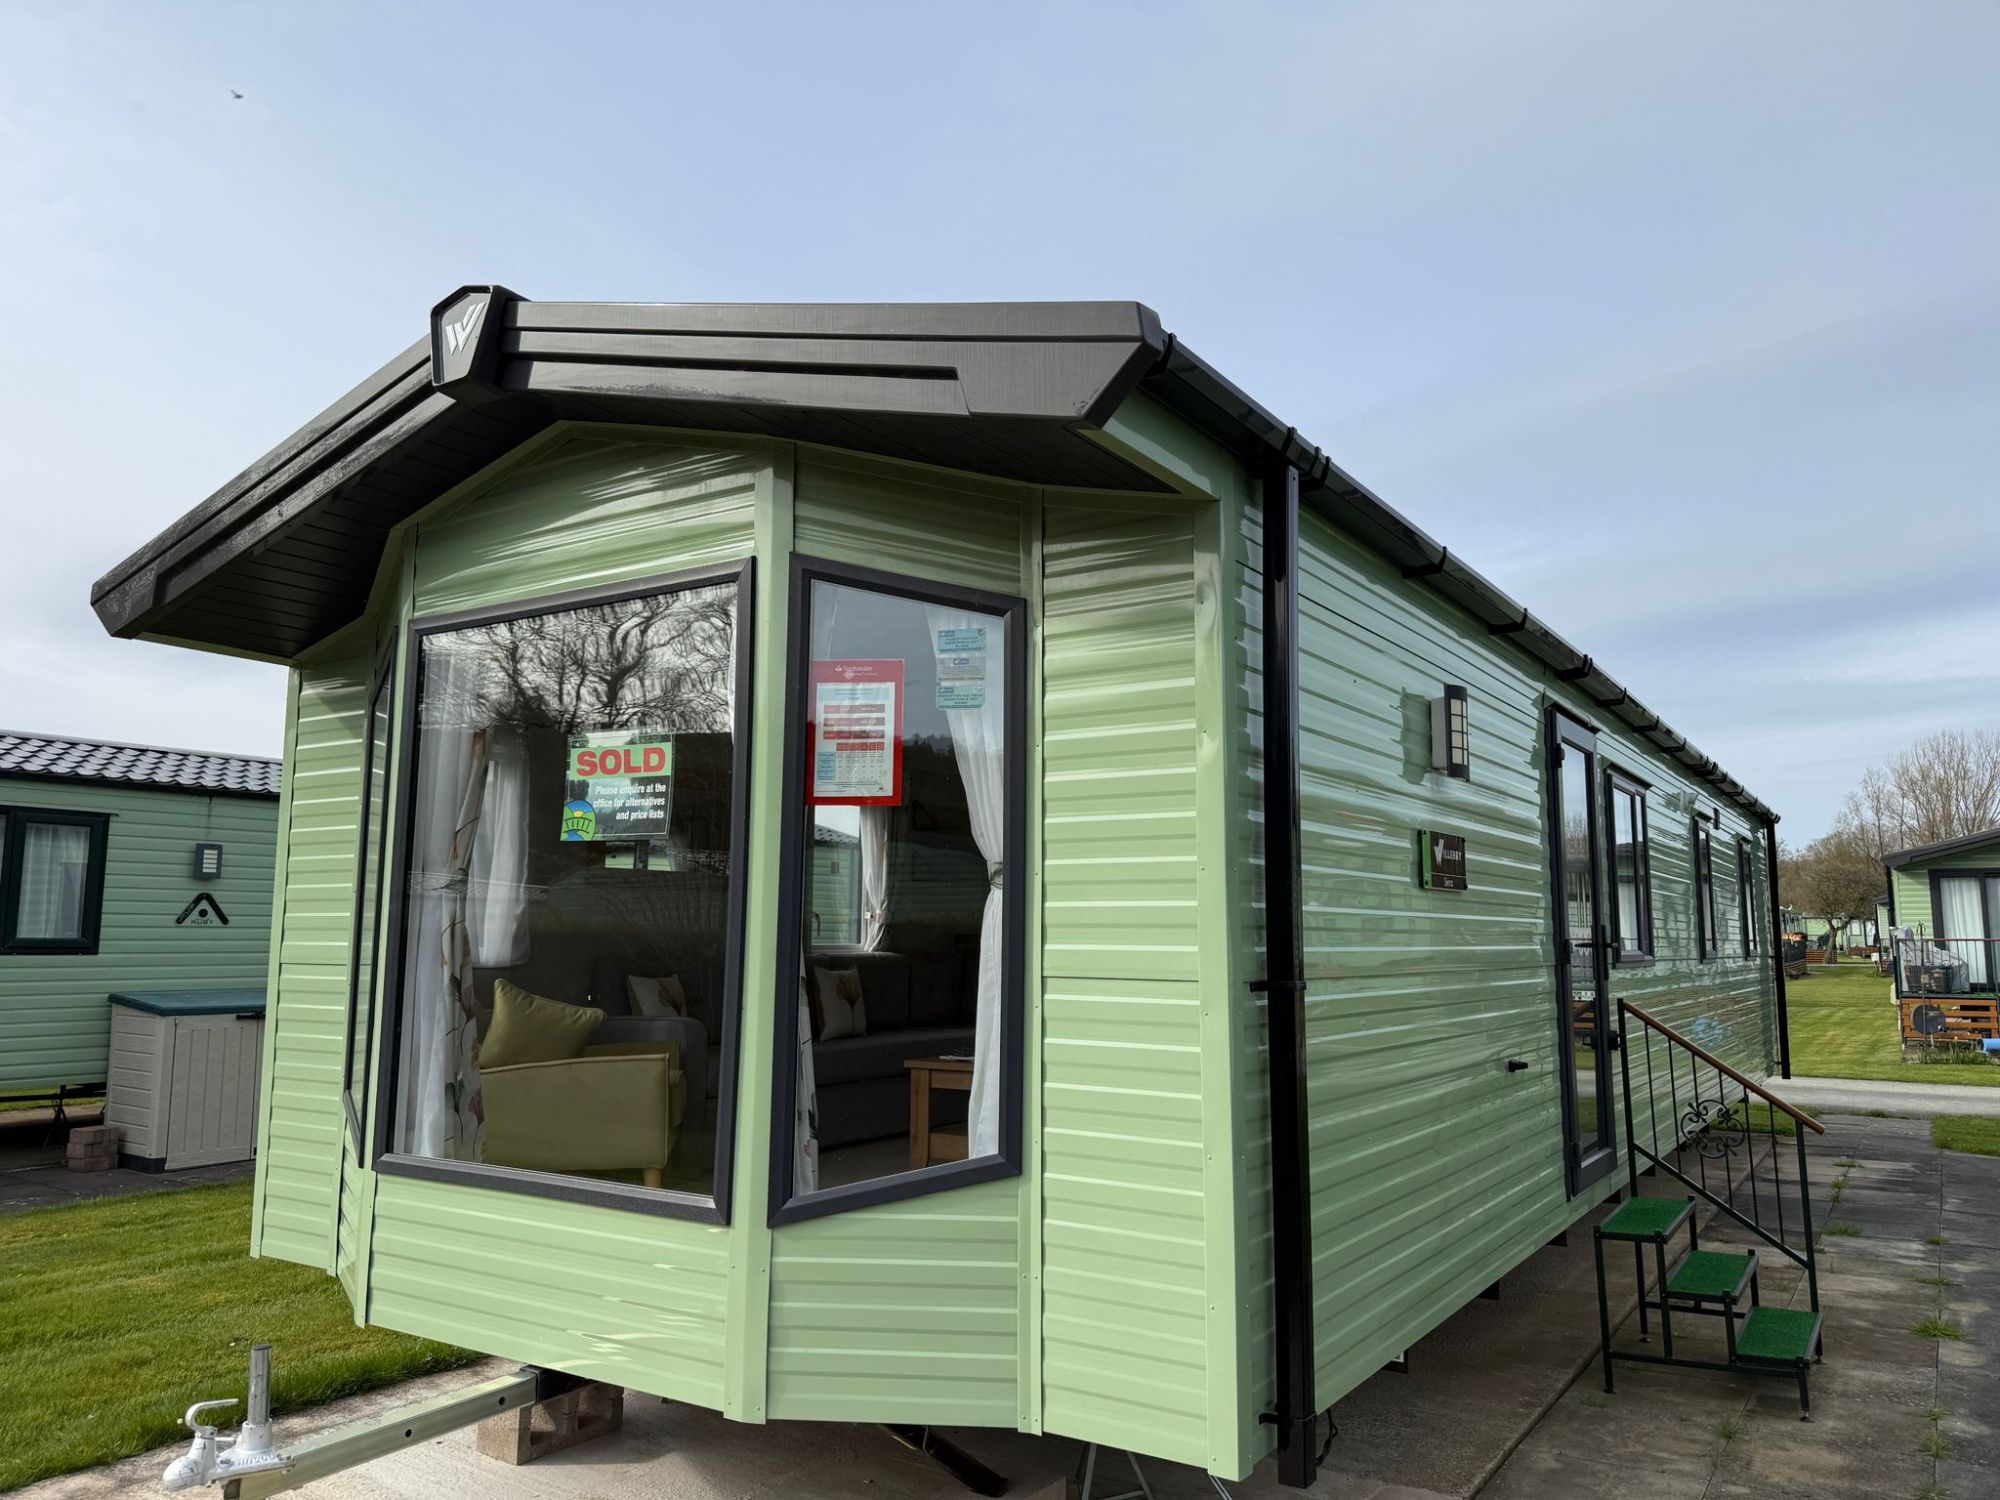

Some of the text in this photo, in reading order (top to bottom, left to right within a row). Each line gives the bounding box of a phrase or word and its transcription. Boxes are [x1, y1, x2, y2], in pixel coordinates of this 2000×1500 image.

[576, 747, 666, 777] SOLD
[595, 783, 667, 795] Please enquire at the
[593, 797, 665, 808] office for alternatives
[616, 810, 665, 821] and price lists
